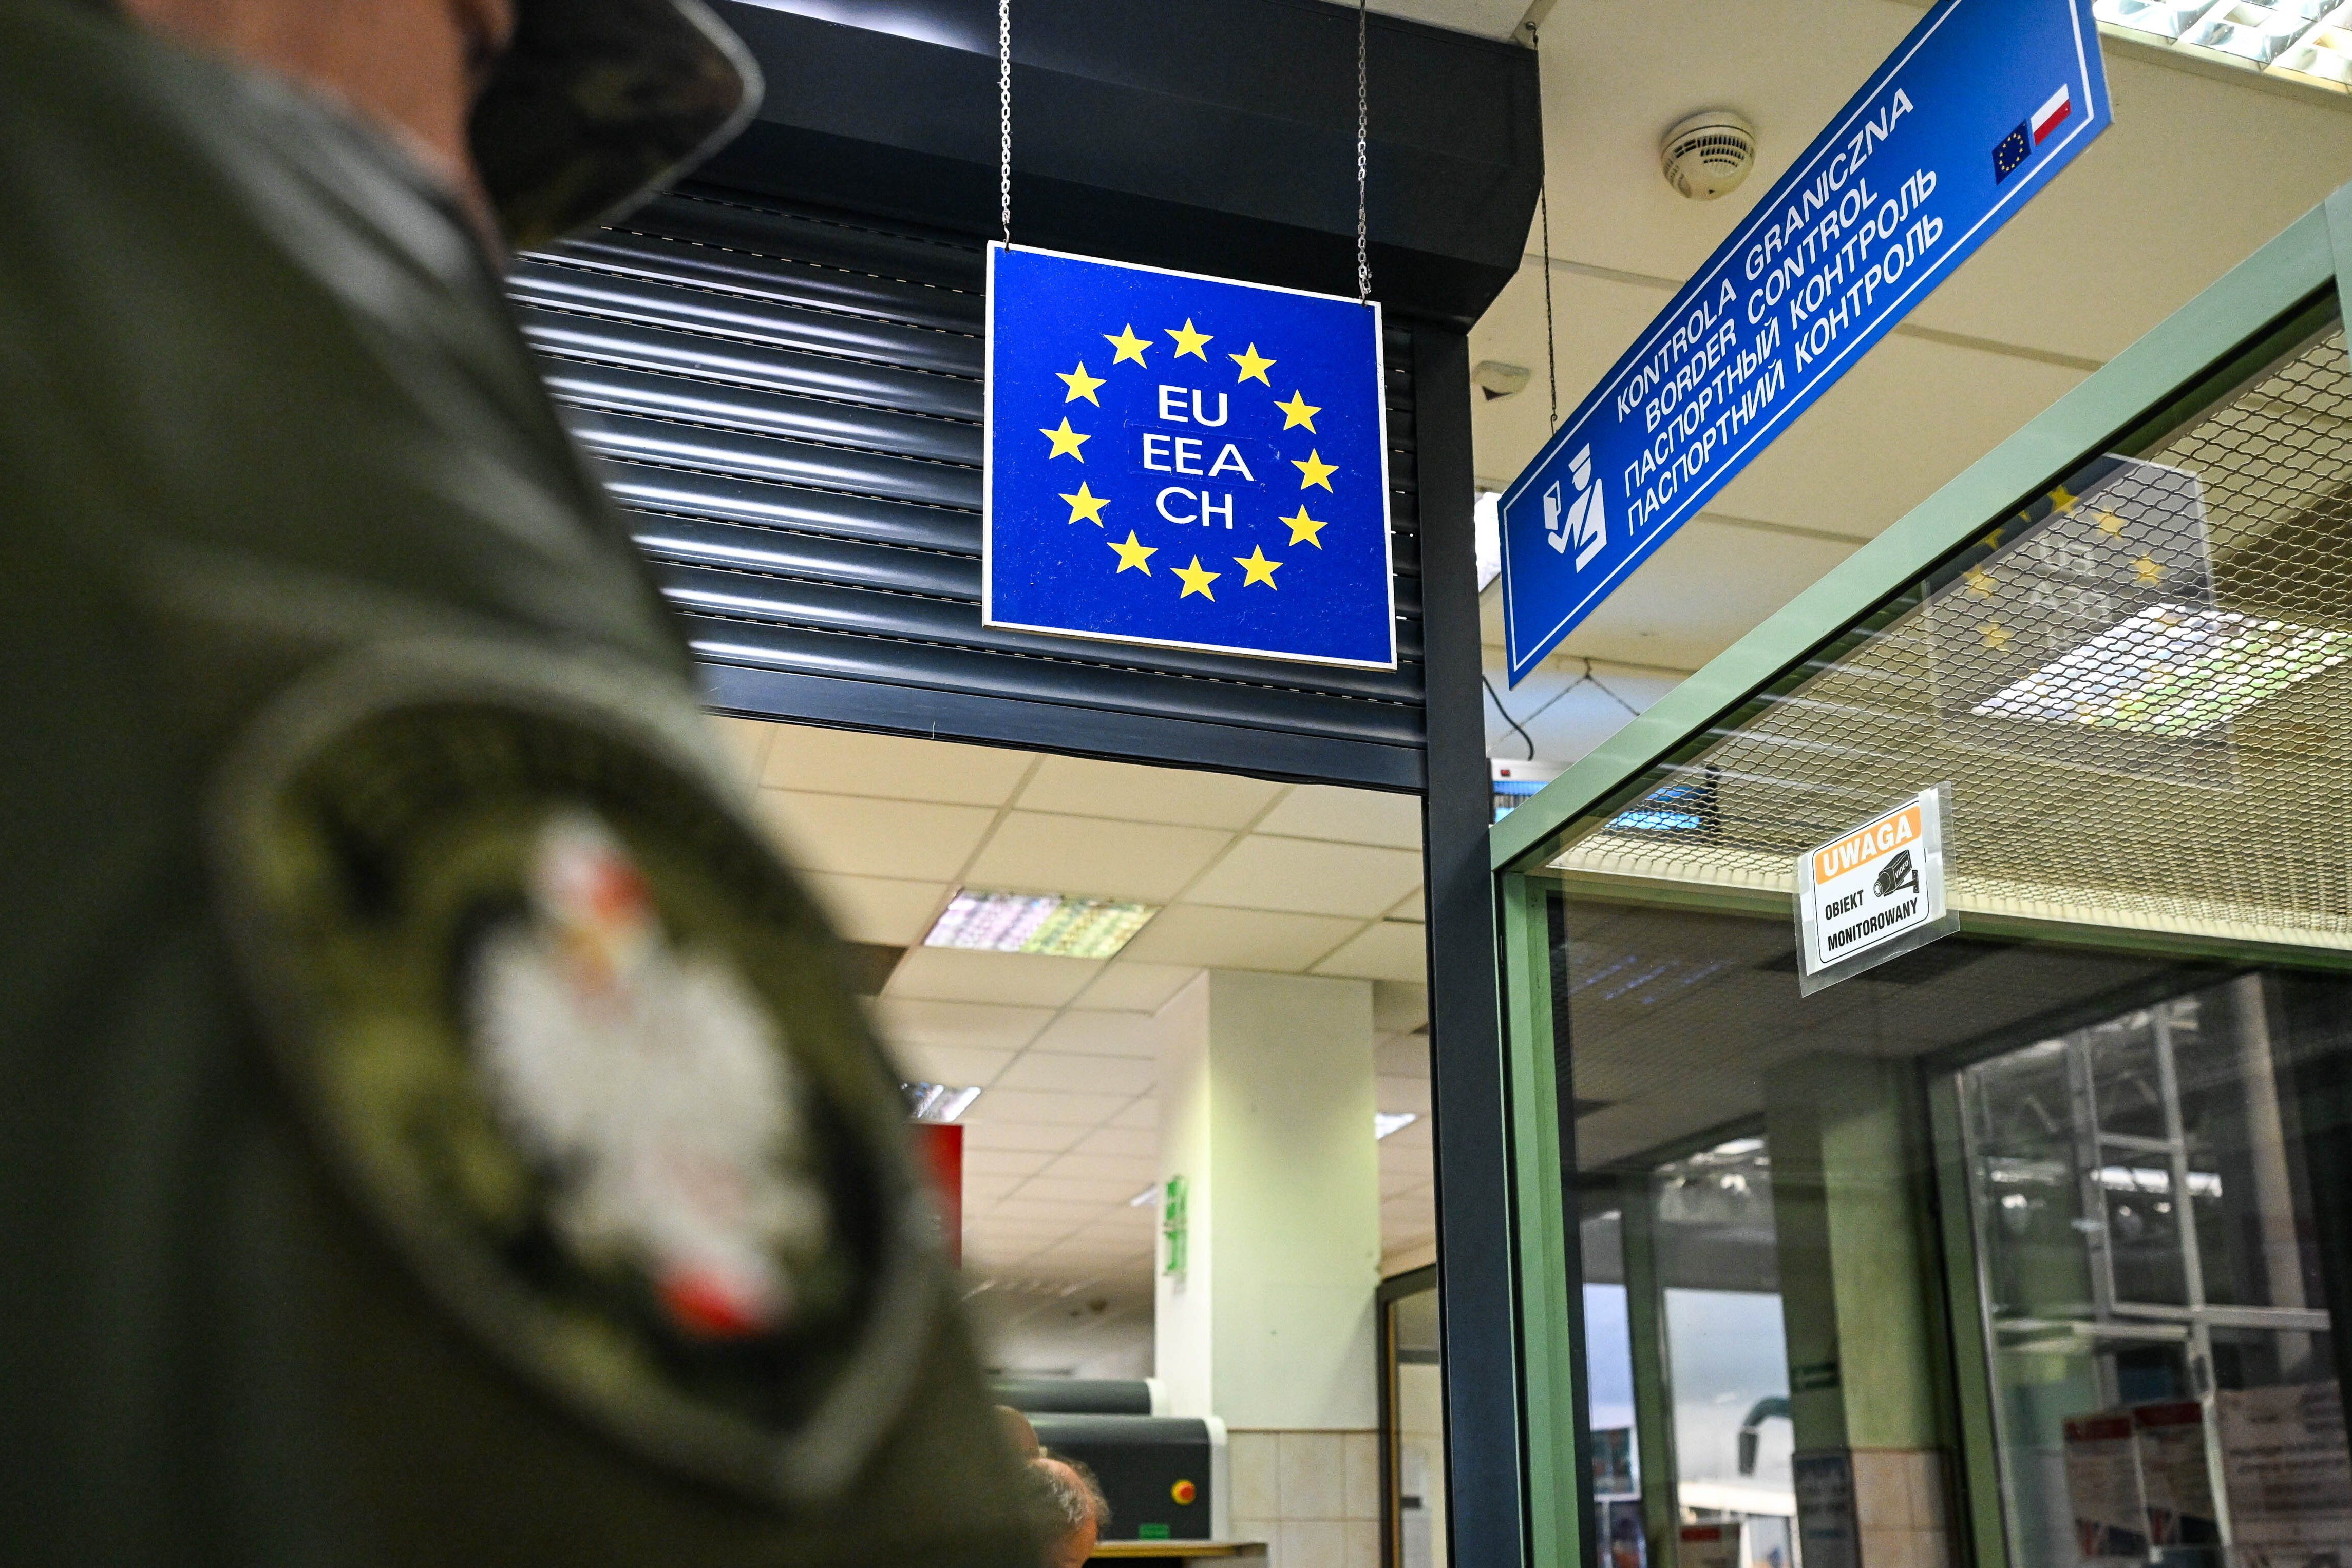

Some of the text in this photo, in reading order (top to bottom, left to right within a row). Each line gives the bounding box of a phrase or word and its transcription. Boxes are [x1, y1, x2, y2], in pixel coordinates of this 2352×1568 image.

[1617, 87, 1913, 423] KONTROLA GRANICZNA
[1646, 177, 1877, 434] BORDER CONTROL
[1625, 168, 1937, 498] ПАСПОРТНЫЙ КОНТРОЛЬ
[1628, 214, 1943, 536] ПАСПОРТНИЙ КОНТРОЛЬ
[1159, 384, 1228, 427] EU
[1143, 433, 1255, 482] EEA
[1156, 486, 1234, 529] CH
[1823, 815, 1913, 877] UWAGA
[1894, 859, 1909, 878] VIDEO
[1825, 889, 1864, 921] OBIEKT
[1828, 897, 1918, 951] MONITOROWANY
